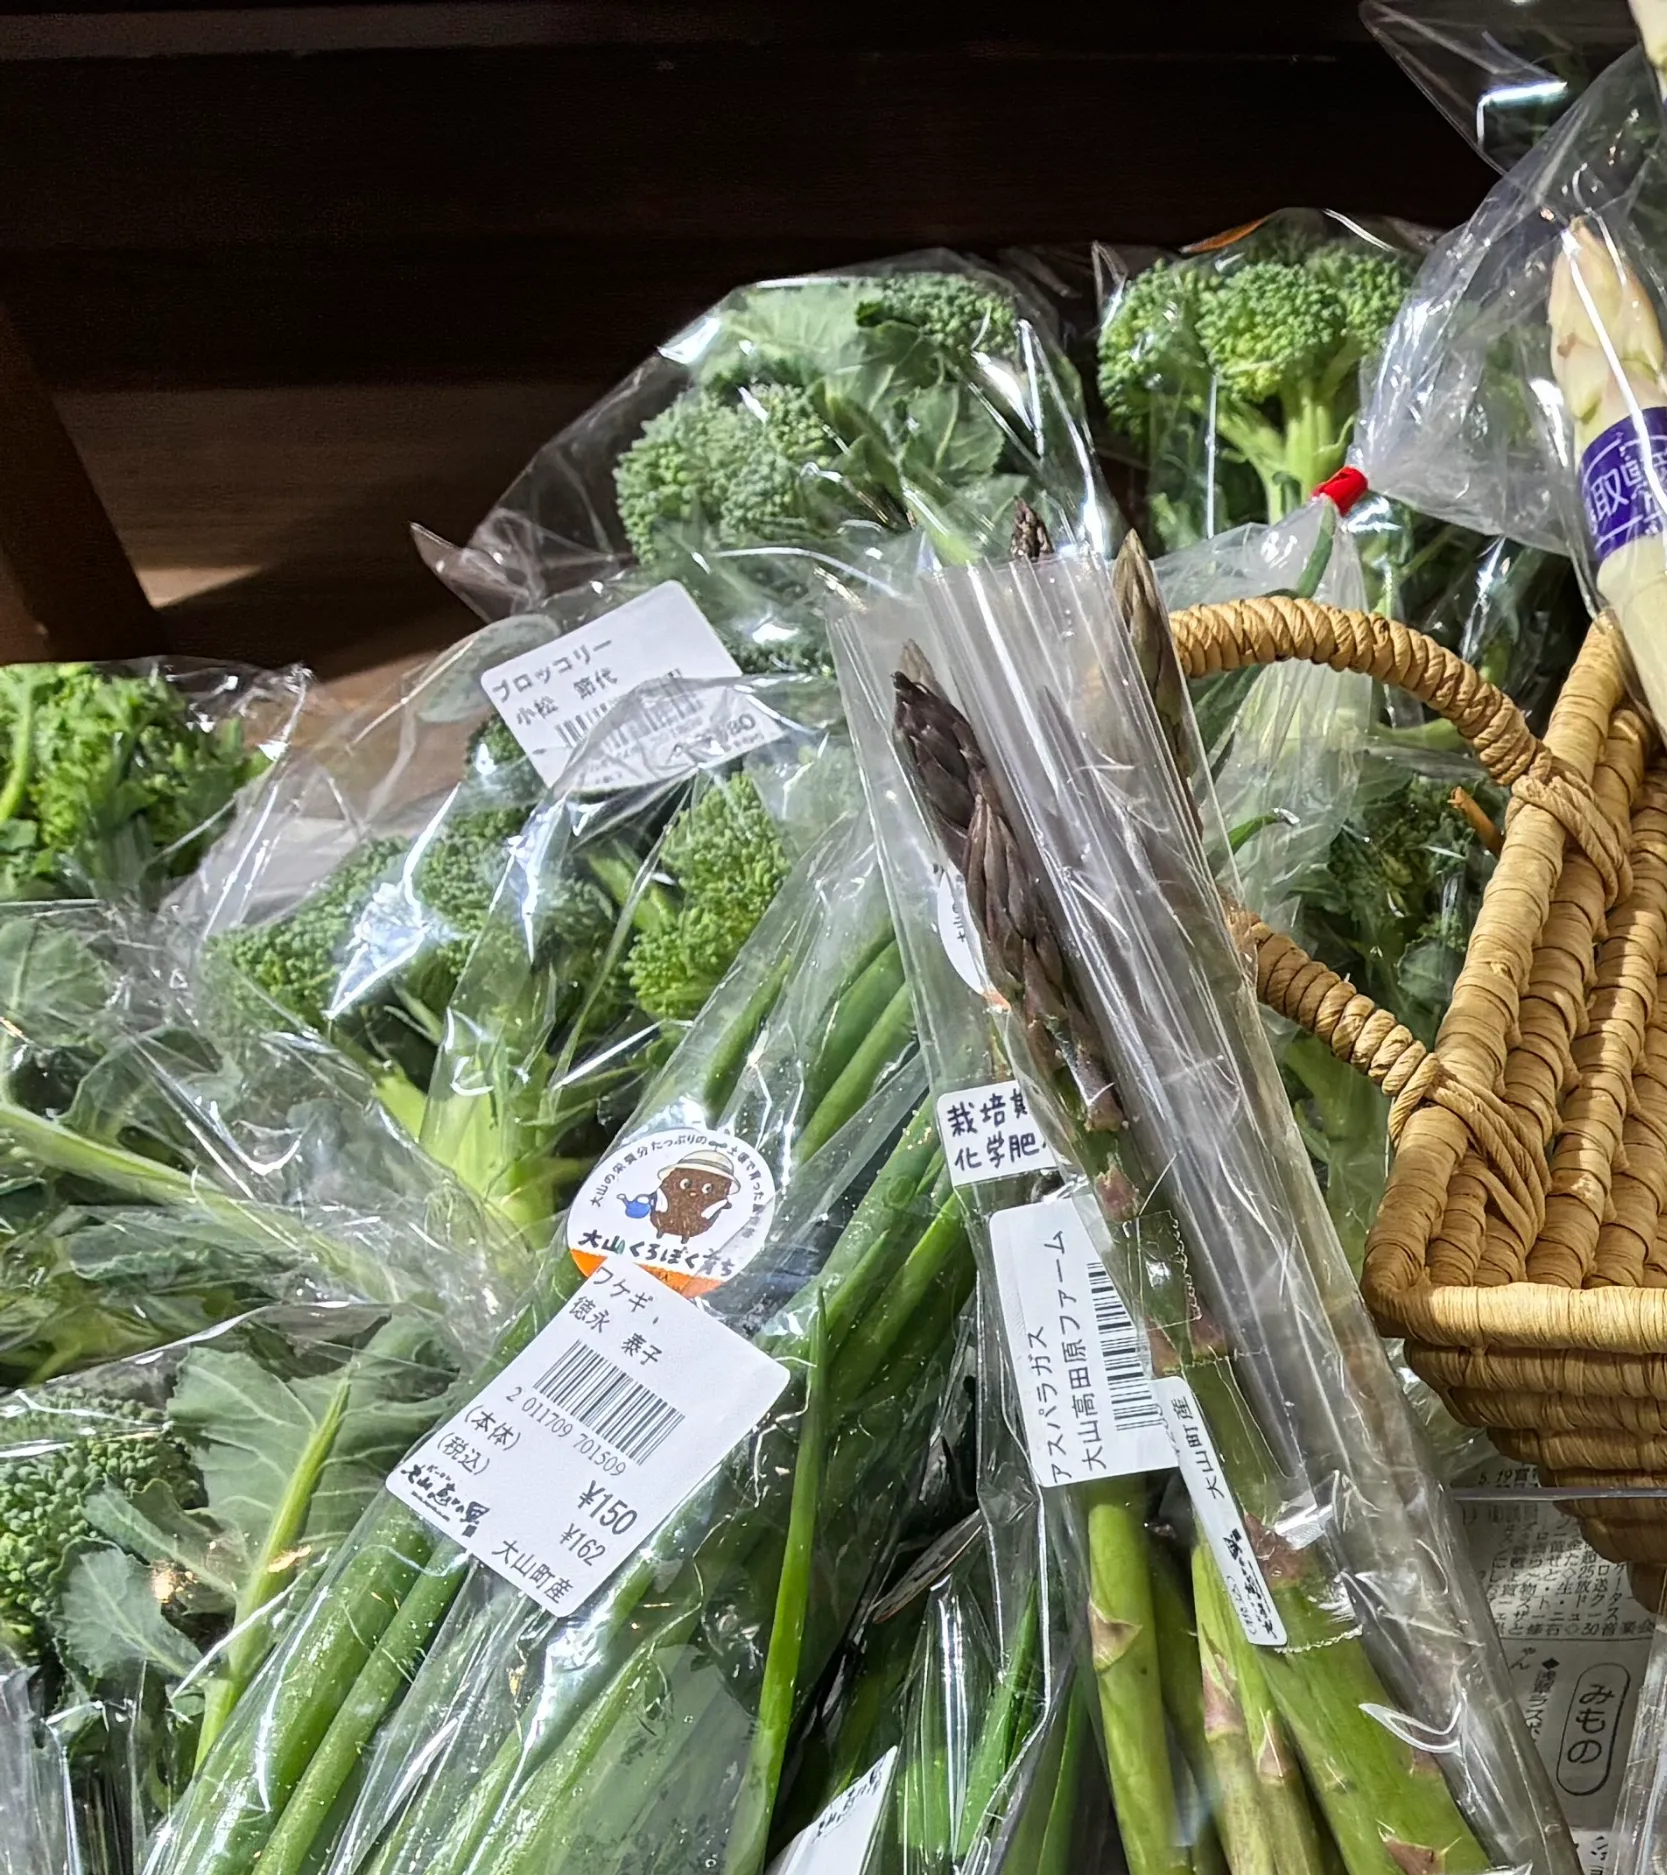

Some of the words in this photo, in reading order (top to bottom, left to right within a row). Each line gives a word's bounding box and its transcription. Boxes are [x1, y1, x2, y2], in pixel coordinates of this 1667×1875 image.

[489, 629, 618, 704] ブロッコリー
[509, 693, 561, 727] 小松
[565, 1293, 617, 1334] 徳永
[617, 1331, 666, 1370] 泰子
[587, 1264, 655, 1315] ワケギ
[1038, 1228, 1109, 1473] 大山高田原ファーム
[518, 1395, 576, 1441] 011709
[568, 1431, 629, 1480] 701509
[1022, 1325, 1074, 1484] アスパラガス
[459, 1401, 526, 1455] (本体)
[570, 1479, 642, 1539] ¥150
[1167, 1394, 1225, 1500] 大山町産
[433, 1428, 494, 1479] (税込)
[555, 1521, 608, 1568] ¥162
[489, 1533, 576, 1606] 大山町産
[1568, 1682, 1617, 1766] みもの
